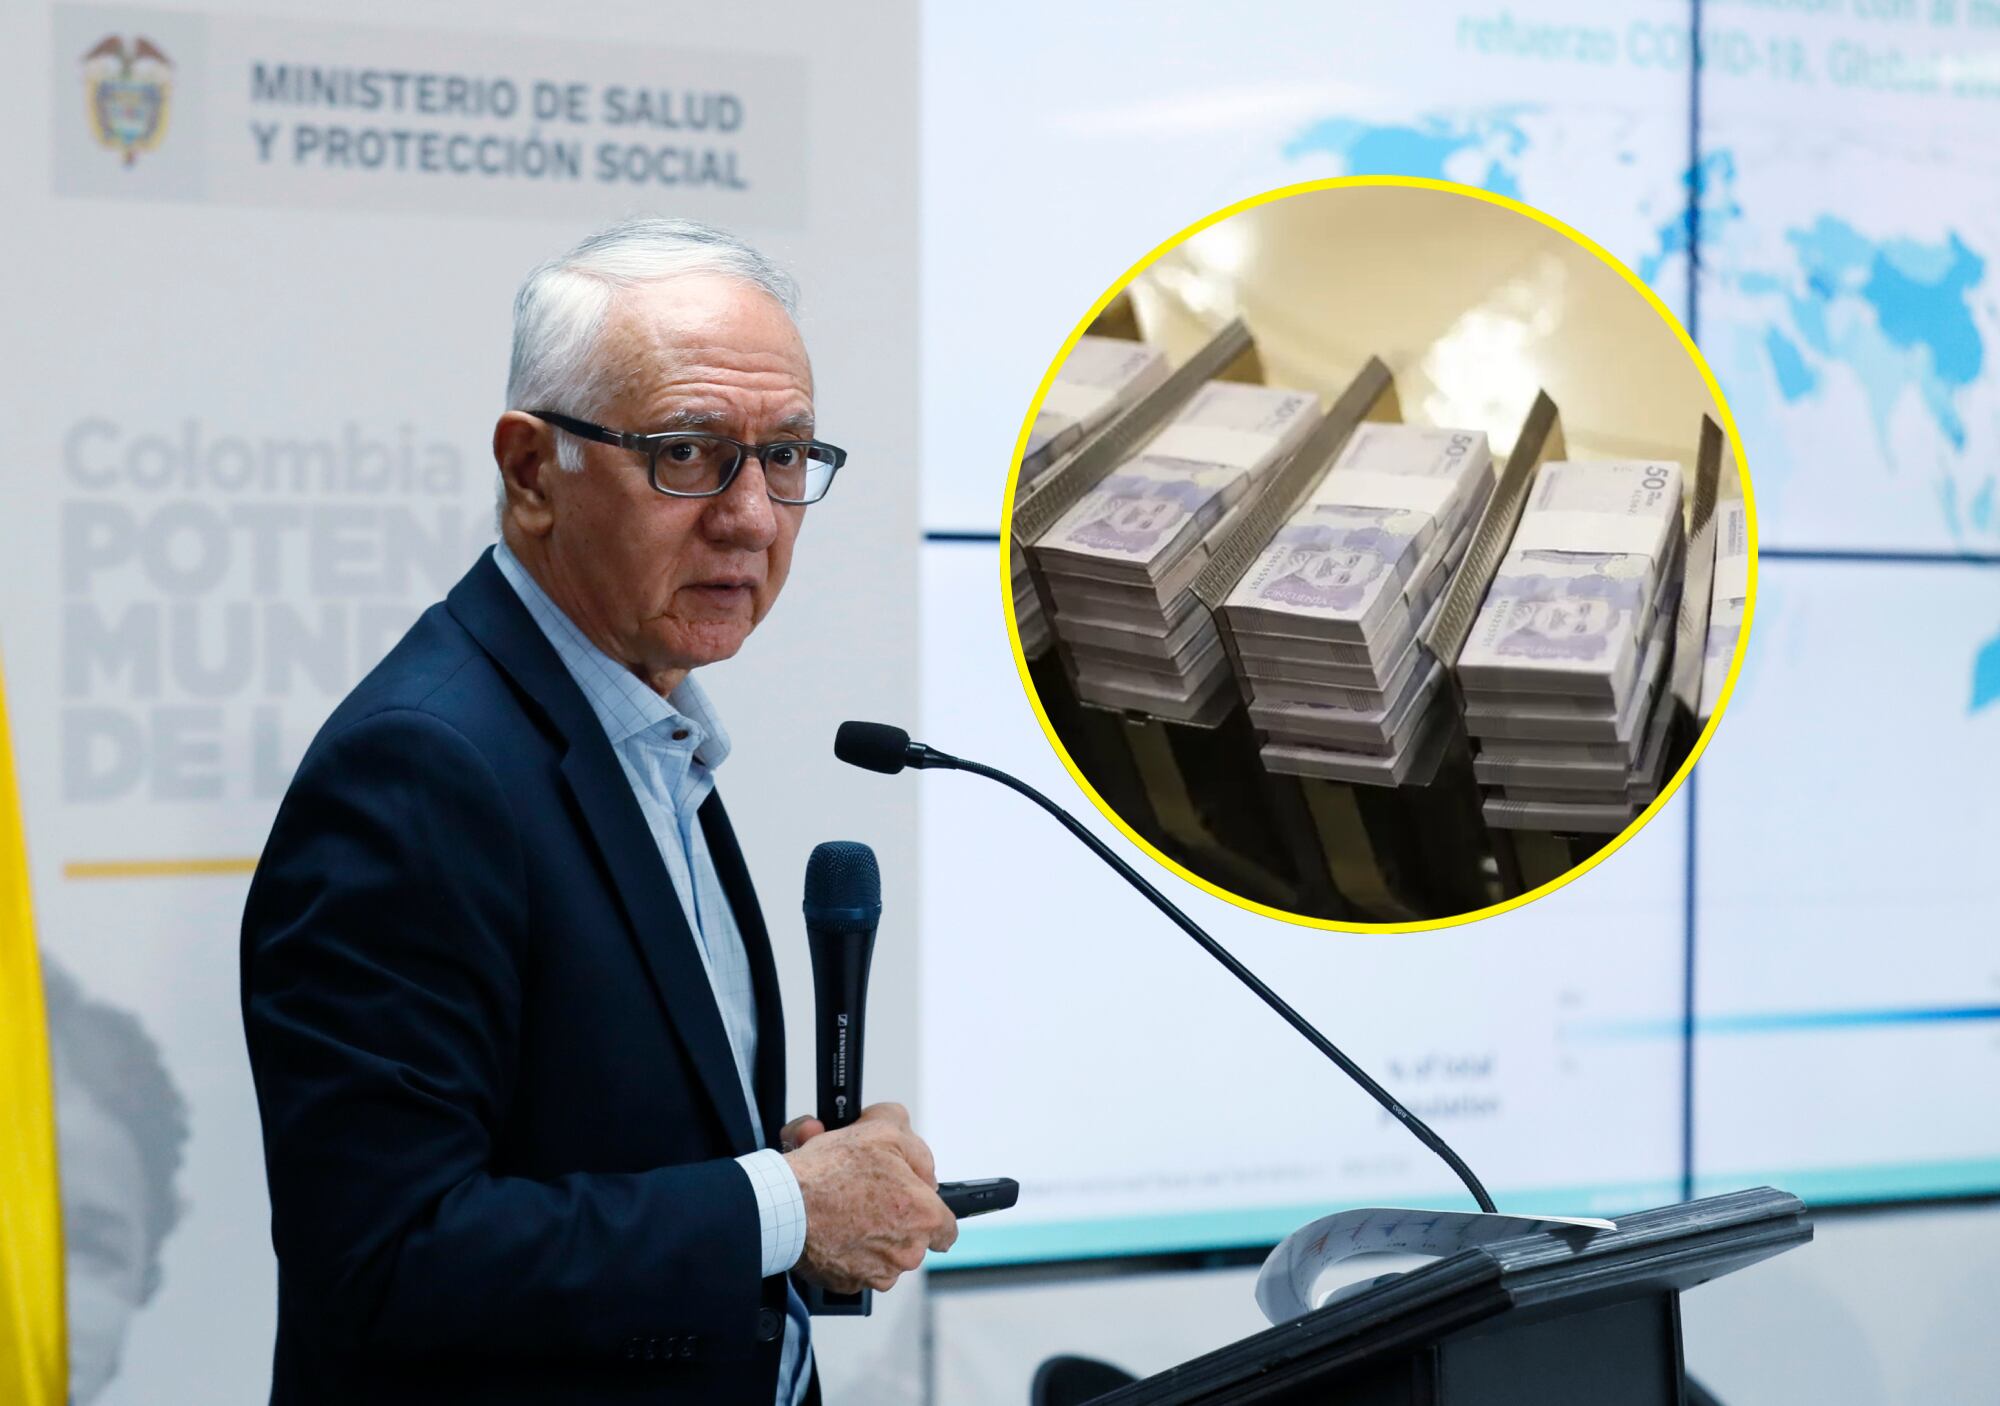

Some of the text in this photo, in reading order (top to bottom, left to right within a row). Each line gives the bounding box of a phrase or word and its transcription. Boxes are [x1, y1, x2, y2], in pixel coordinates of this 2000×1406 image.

[1456, 13, 1618, 66] refuerzo
[250, 61, 744, 134] MINISTERIO DE SALUD
[250, 122, 749, 190] Y PROTECCIÓN SOCIAL
[62, 416, 465, 494] Colombia
[1641, 465, 1670, 490] 50
[60, 499, 496, 598] POTEN
[61, 704, 225, 801] DE
[838, 1028, 846, 1087] SENNHEISER
